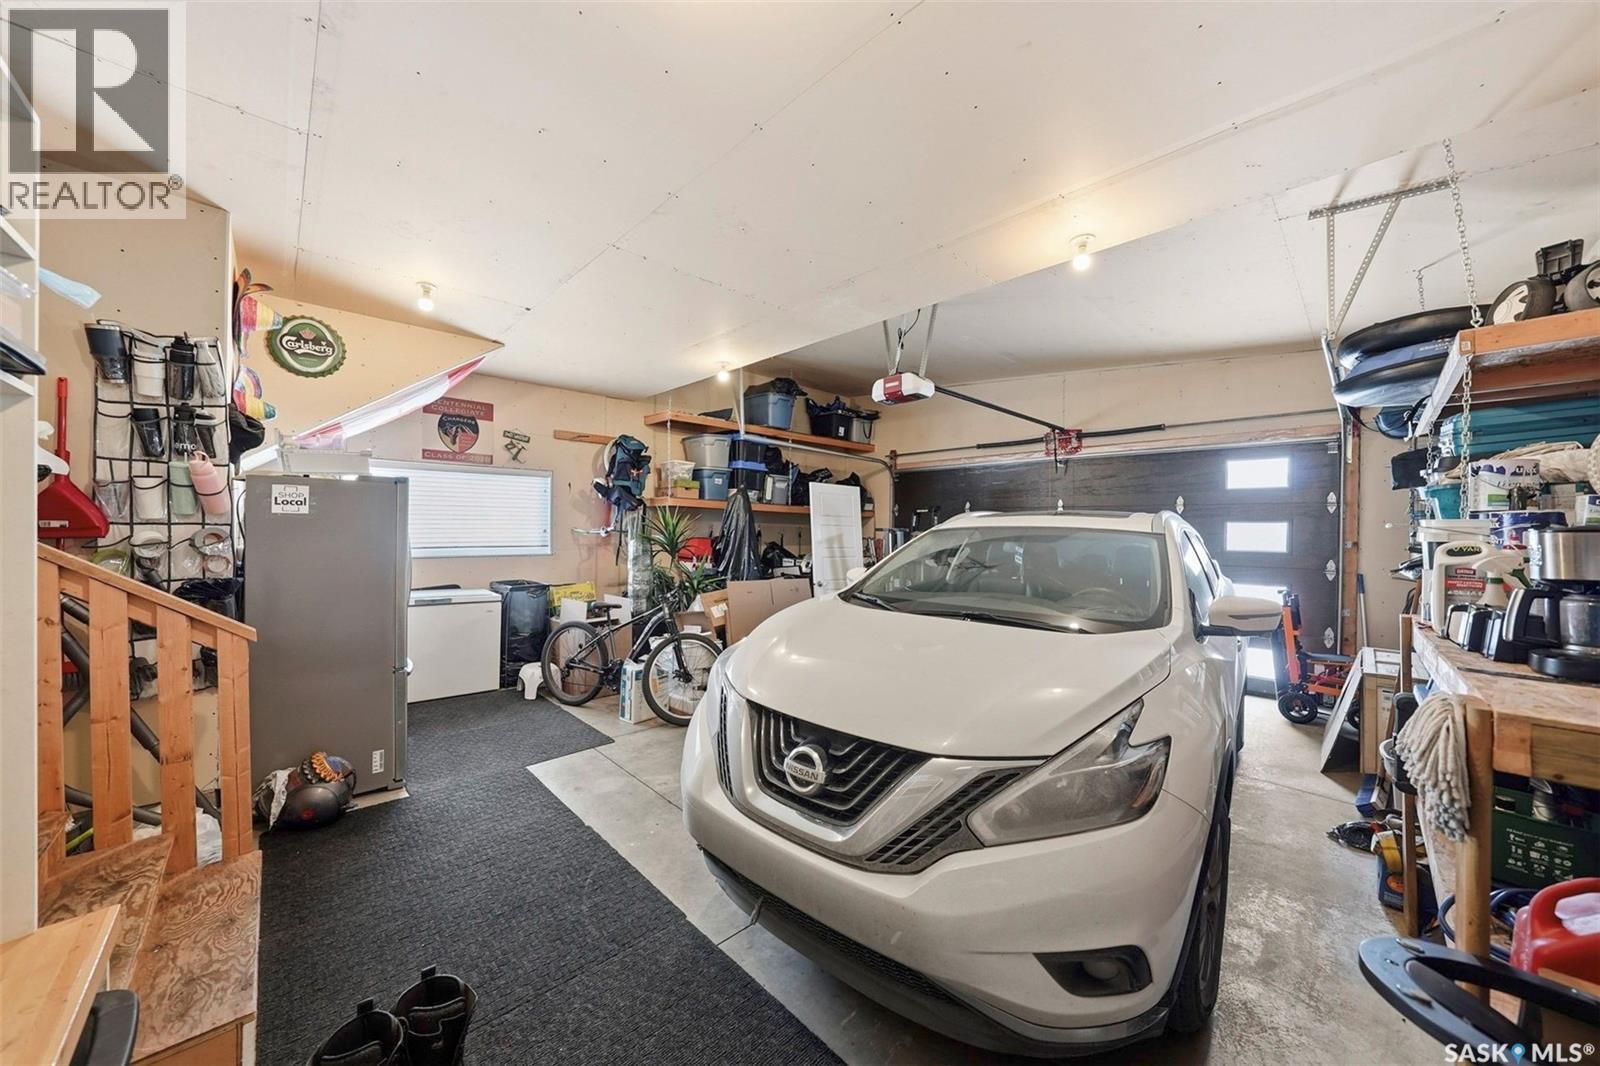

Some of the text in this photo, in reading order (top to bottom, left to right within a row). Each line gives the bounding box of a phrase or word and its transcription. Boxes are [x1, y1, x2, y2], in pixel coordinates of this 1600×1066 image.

[281, 335, 333, 356] Carlsberg
[431, 403, 486, 416] COLLEGIATE
[424, 450, 454, 460] CLASS
[274, 495, 307, 507] Local
[278, 491, 305, 499] SHOP
[786, 762, 819, 781] NISSAN
